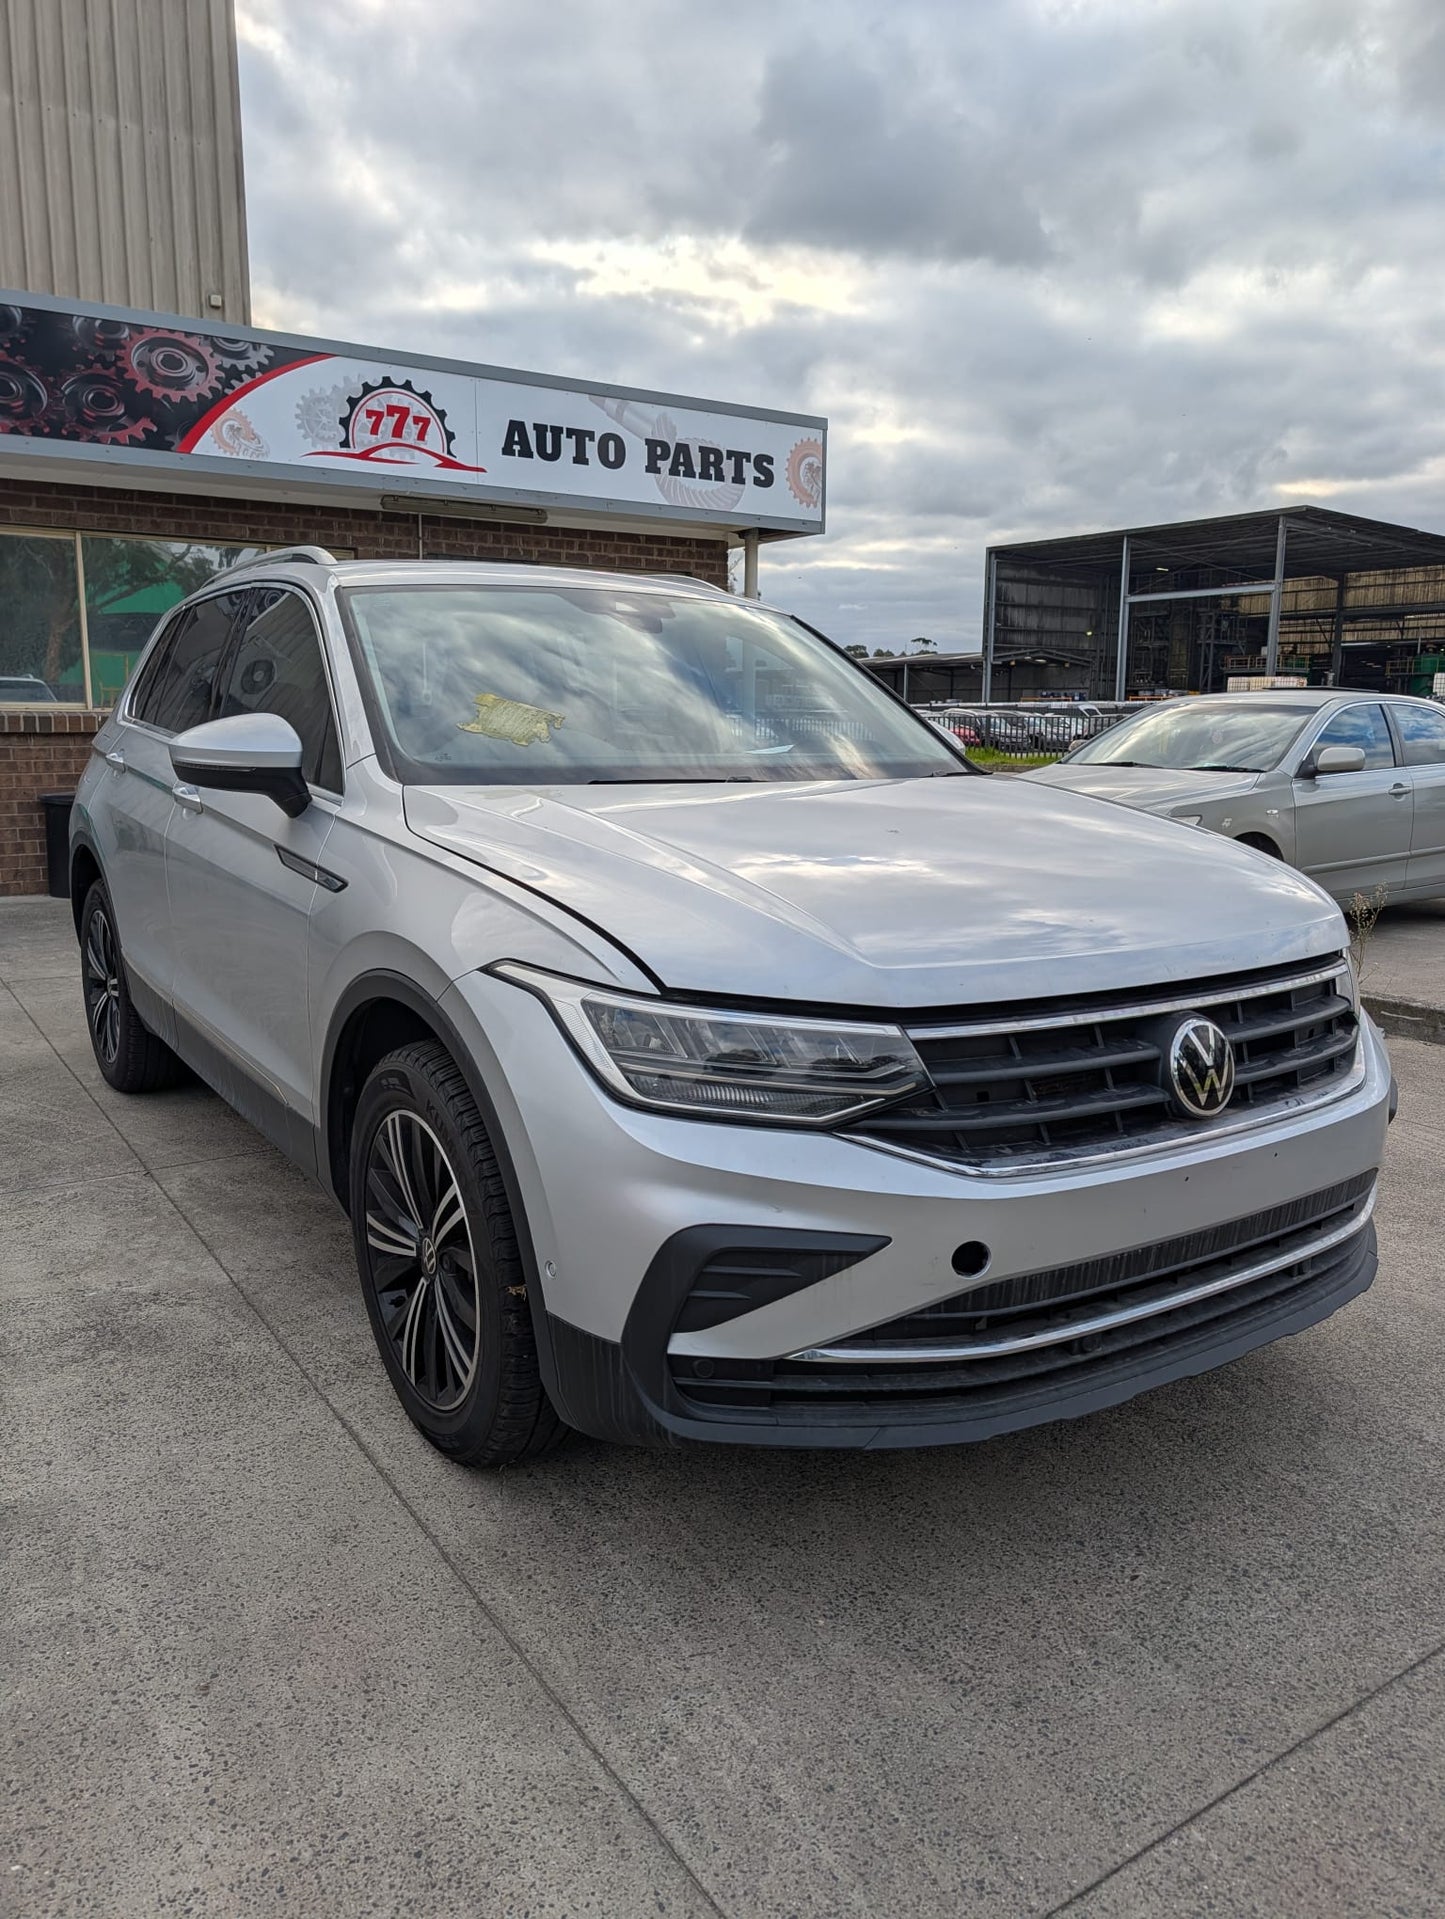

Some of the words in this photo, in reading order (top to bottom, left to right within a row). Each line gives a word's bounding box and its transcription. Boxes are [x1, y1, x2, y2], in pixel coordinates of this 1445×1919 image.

[366, 404, 431, 442] 777
[501, 419, 627, 470] AUTO
[644, 438, 775, 489] PARTS
[1177, 1023, 1230, 1107] VW
